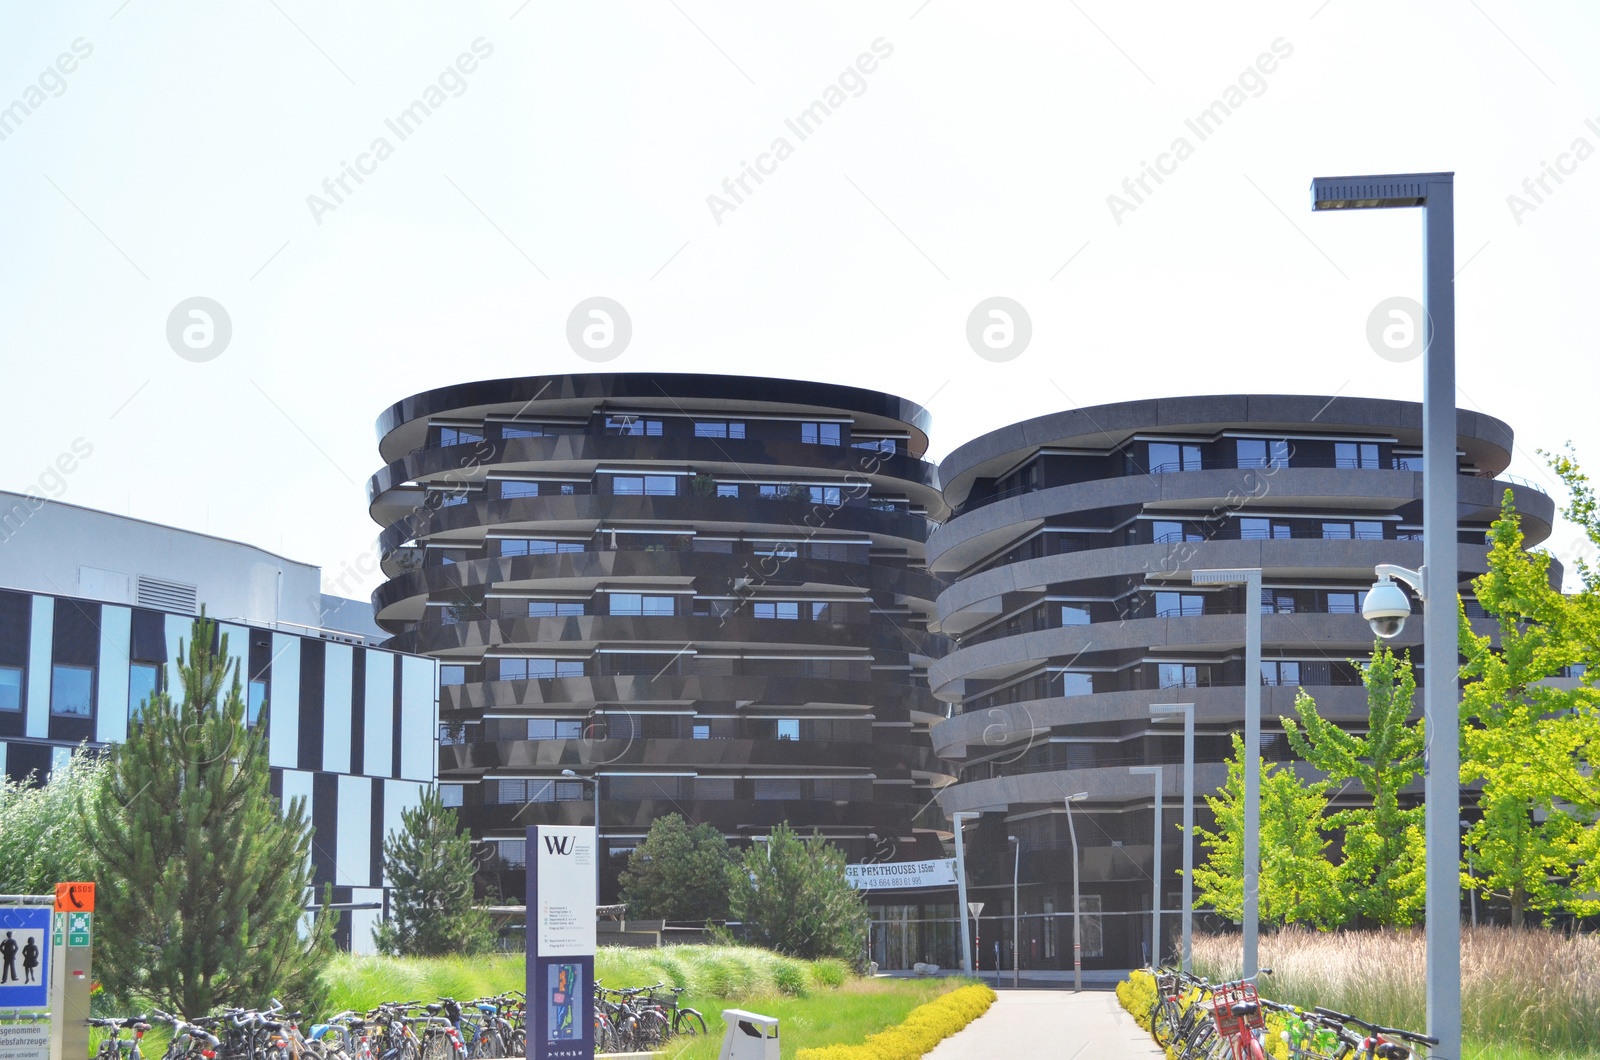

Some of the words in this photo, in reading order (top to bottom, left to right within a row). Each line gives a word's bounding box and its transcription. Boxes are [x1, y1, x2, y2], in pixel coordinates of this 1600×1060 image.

[544, 836, 576, 855] WU
[861, 864, 916, 876] PENTHOUSES
[879, 878, 890, 886] 664
[892, 878, 902, 886] 883
[904, 877, 911, 885] 61
